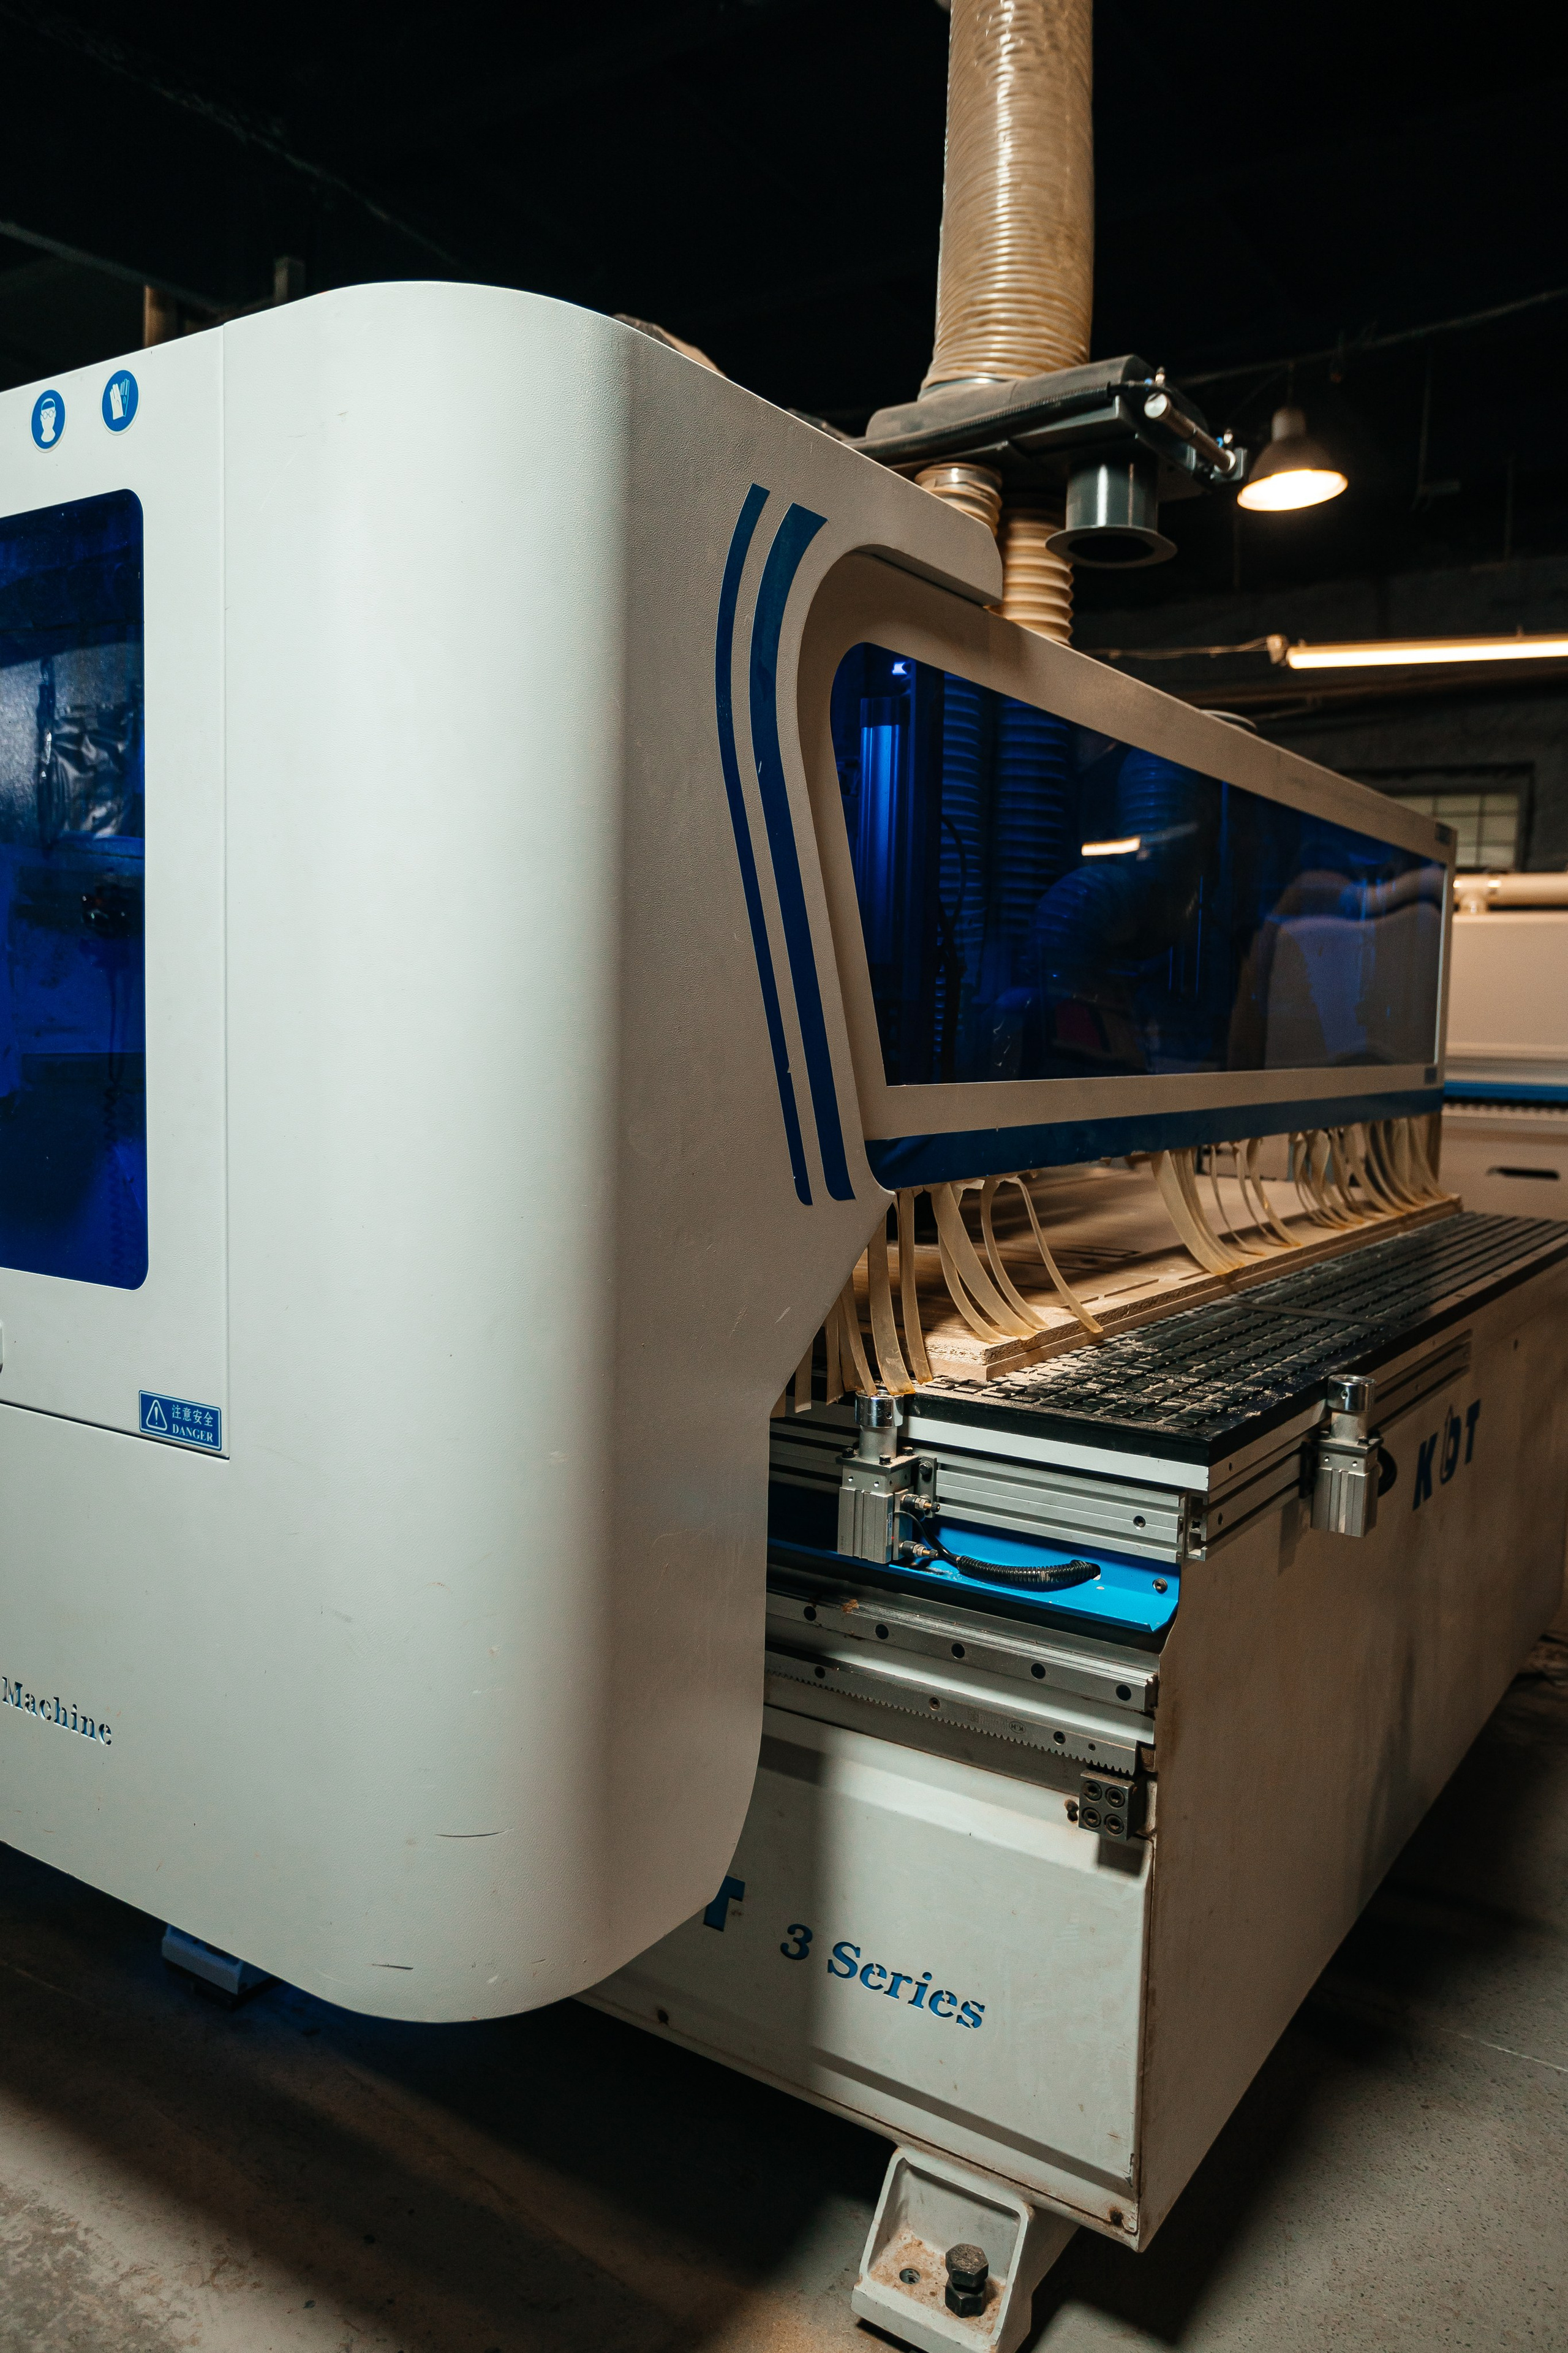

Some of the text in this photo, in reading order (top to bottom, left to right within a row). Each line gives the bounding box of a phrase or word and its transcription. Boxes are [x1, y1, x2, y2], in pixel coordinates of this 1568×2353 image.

[172, 1404, 213, 1427] 注意安全
[172, 1424, 213, 1442] DANGER
[1412, 1399, 1480, 1511] KDT
[2, 1676, 112, 1746] Machine
[780, 1923, 813, 1960] 3
[827, 1941, 986, 2029] Series
